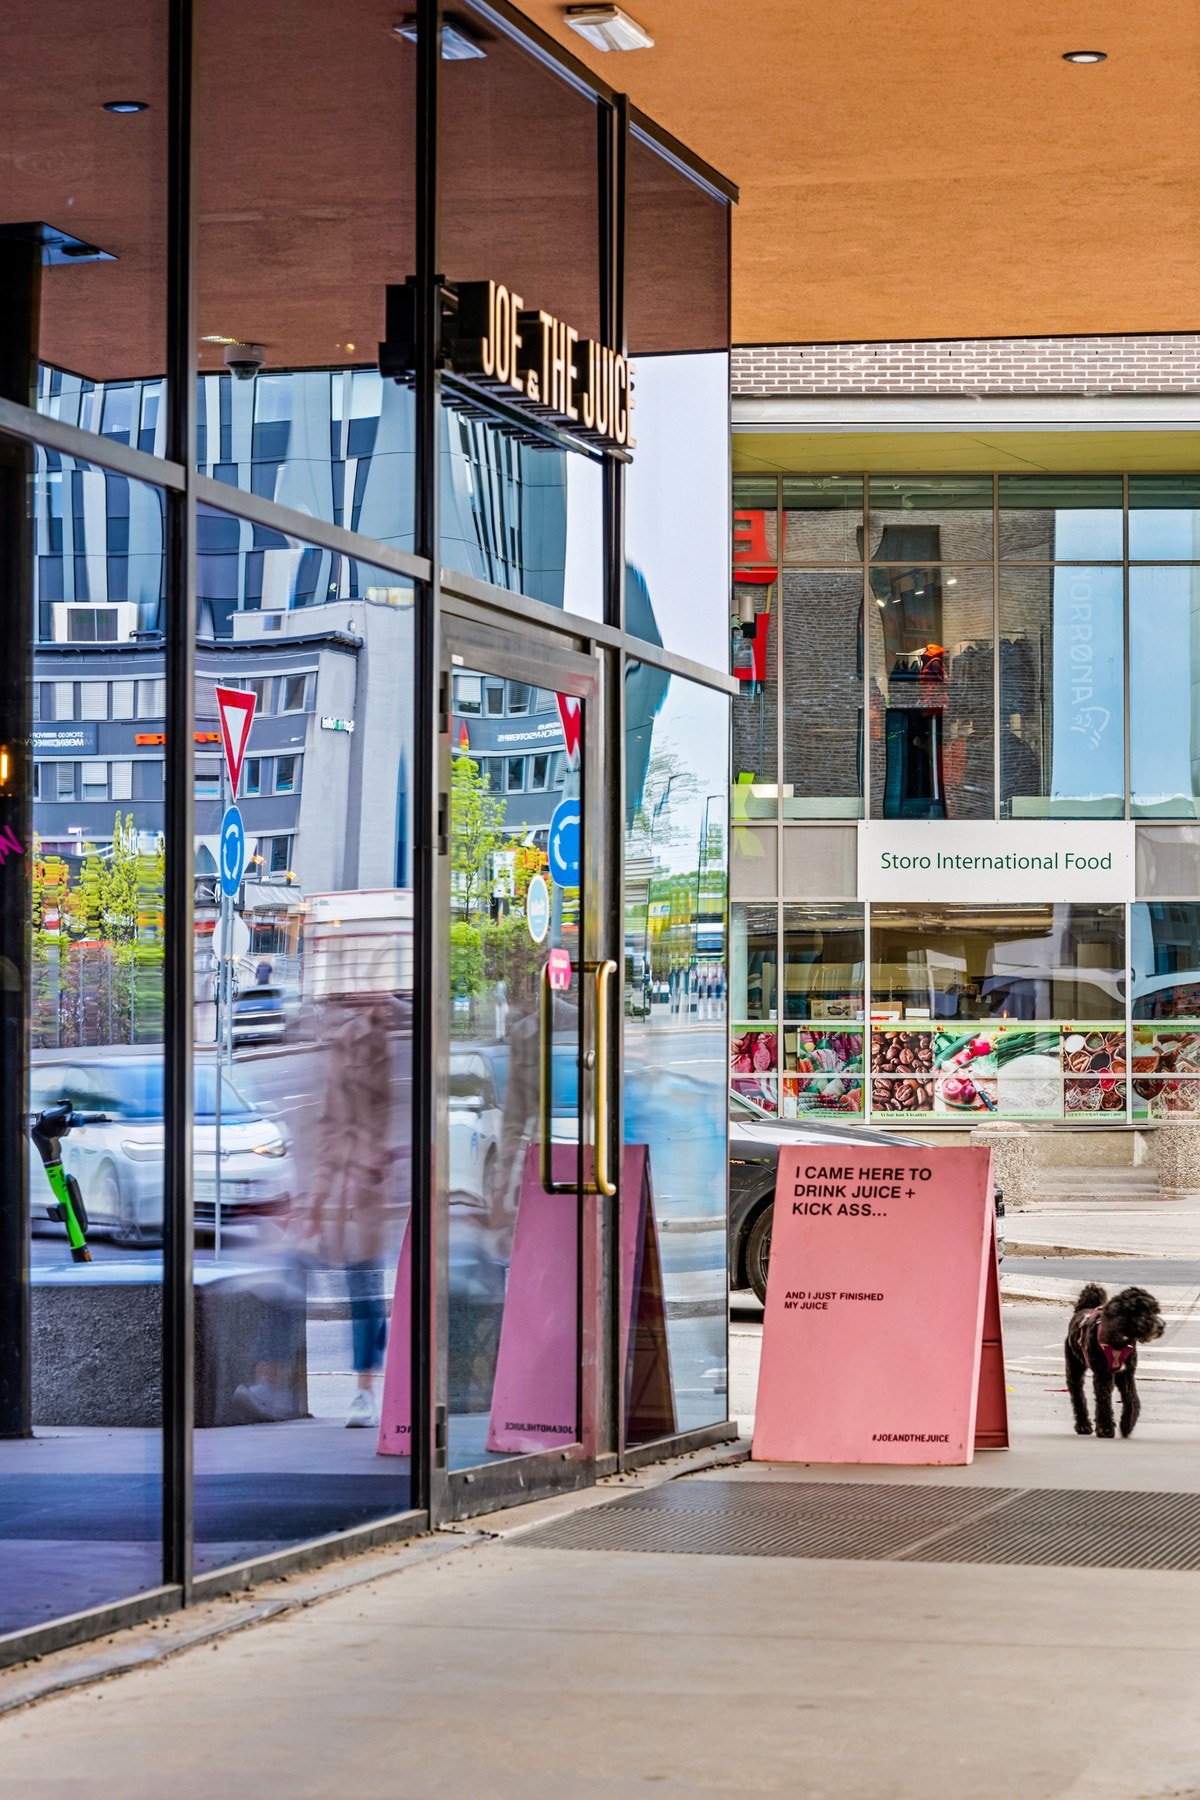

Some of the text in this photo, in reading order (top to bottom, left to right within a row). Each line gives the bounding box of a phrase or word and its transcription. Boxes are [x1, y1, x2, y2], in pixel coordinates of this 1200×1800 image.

[482, 279, 636, 449] JOE & THE JUICE
[881, 852, 1112, 870] Storo International Food
[796, 1166, 932, 1181] I CAME HERE TO
[794, 1184, 916, 1199] DRINK JUICE +
[792, 1202, 887, 1217] KICK ASS...
[785, 1291, 884, 1301] AND I JUST FINISHED
[784, 1301, 828, 1310] MY JUICE
[872, 1433, 949, 1443] #JOEANDTHEJUICE
